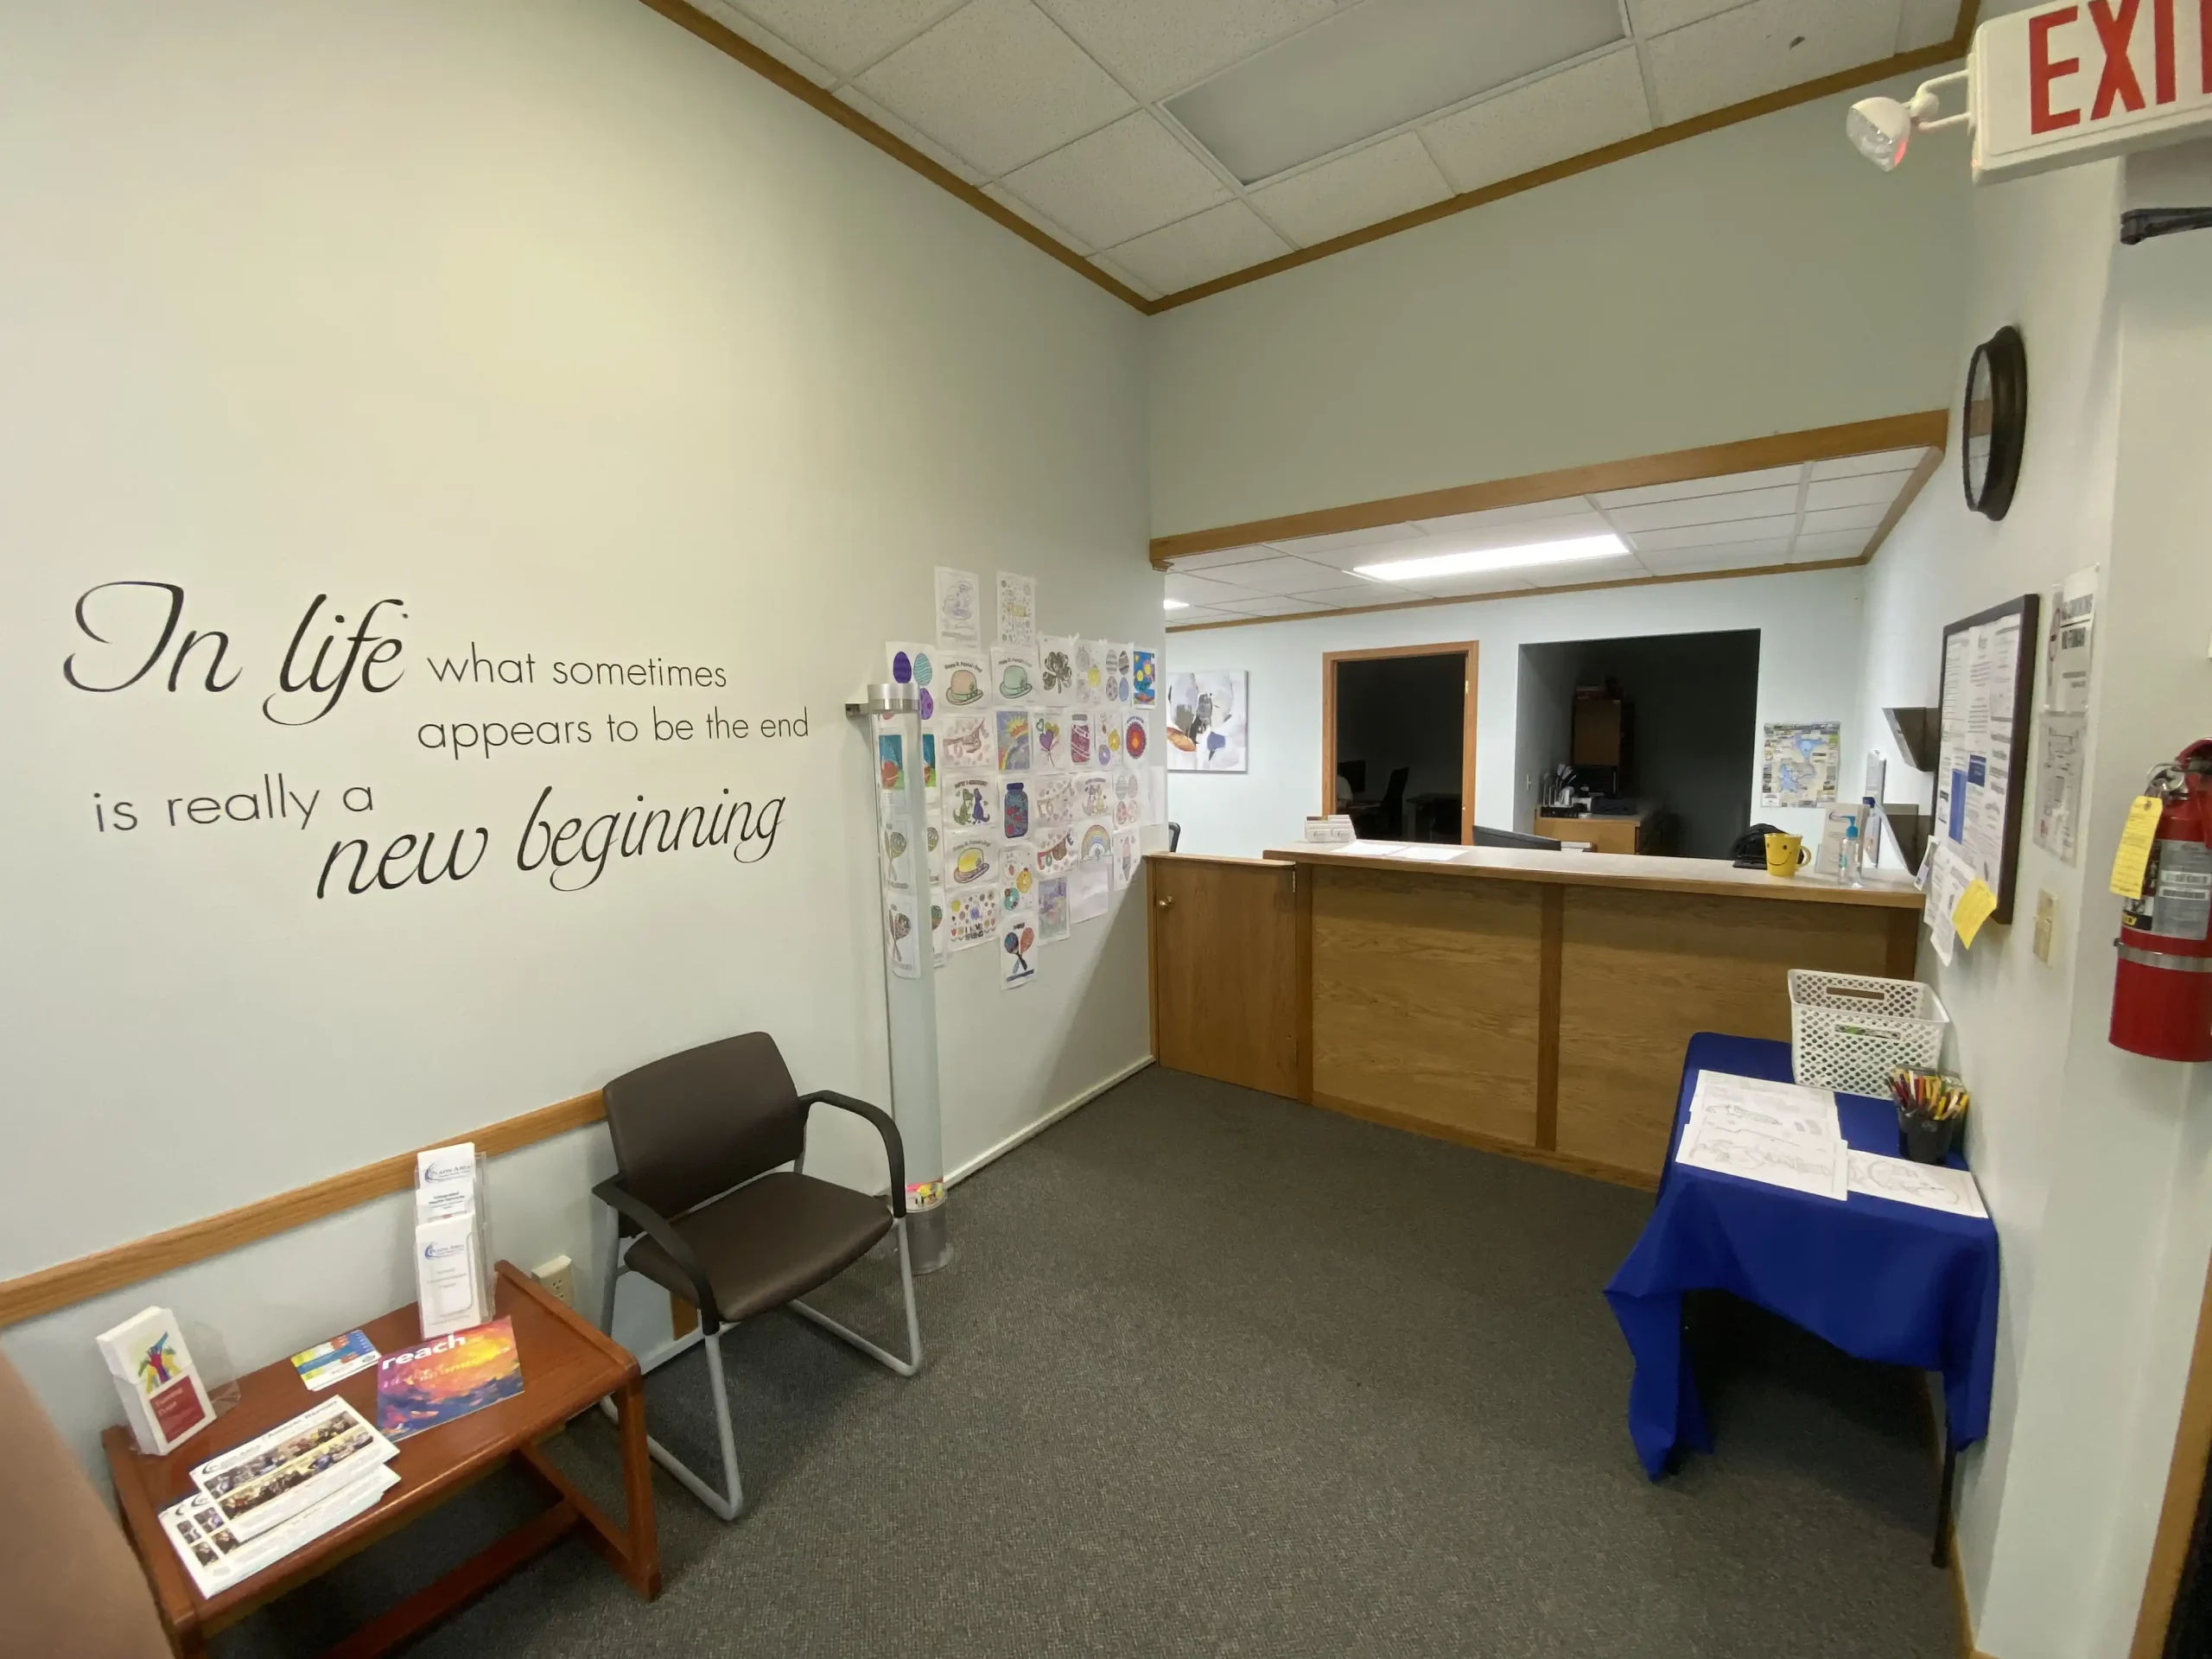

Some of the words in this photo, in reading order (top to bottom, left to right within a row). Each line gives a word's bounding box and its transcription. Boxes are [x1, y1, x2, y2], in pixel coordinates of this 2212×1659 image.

[63, 582, 243, 692] In
[263, 594, 405, 726] life
[427, 641, 536, 683] what
[553, 658, 727, 688] sometimes
[418, 721, 593, 760] appears
[607, 714, 639, 742] to
[653, 706, 694, 741] be
[707, 706, 749, 739] the
[760, 706, 809, 738] end
[93, 792, 138, 832] is
[167, 772, 320, 830] really
[343, 787, 373, 812] a
[317, 827, 489, 899] new
[517, 785, 786, 892] beginning
[382, 1333, 466, 1370] reach
